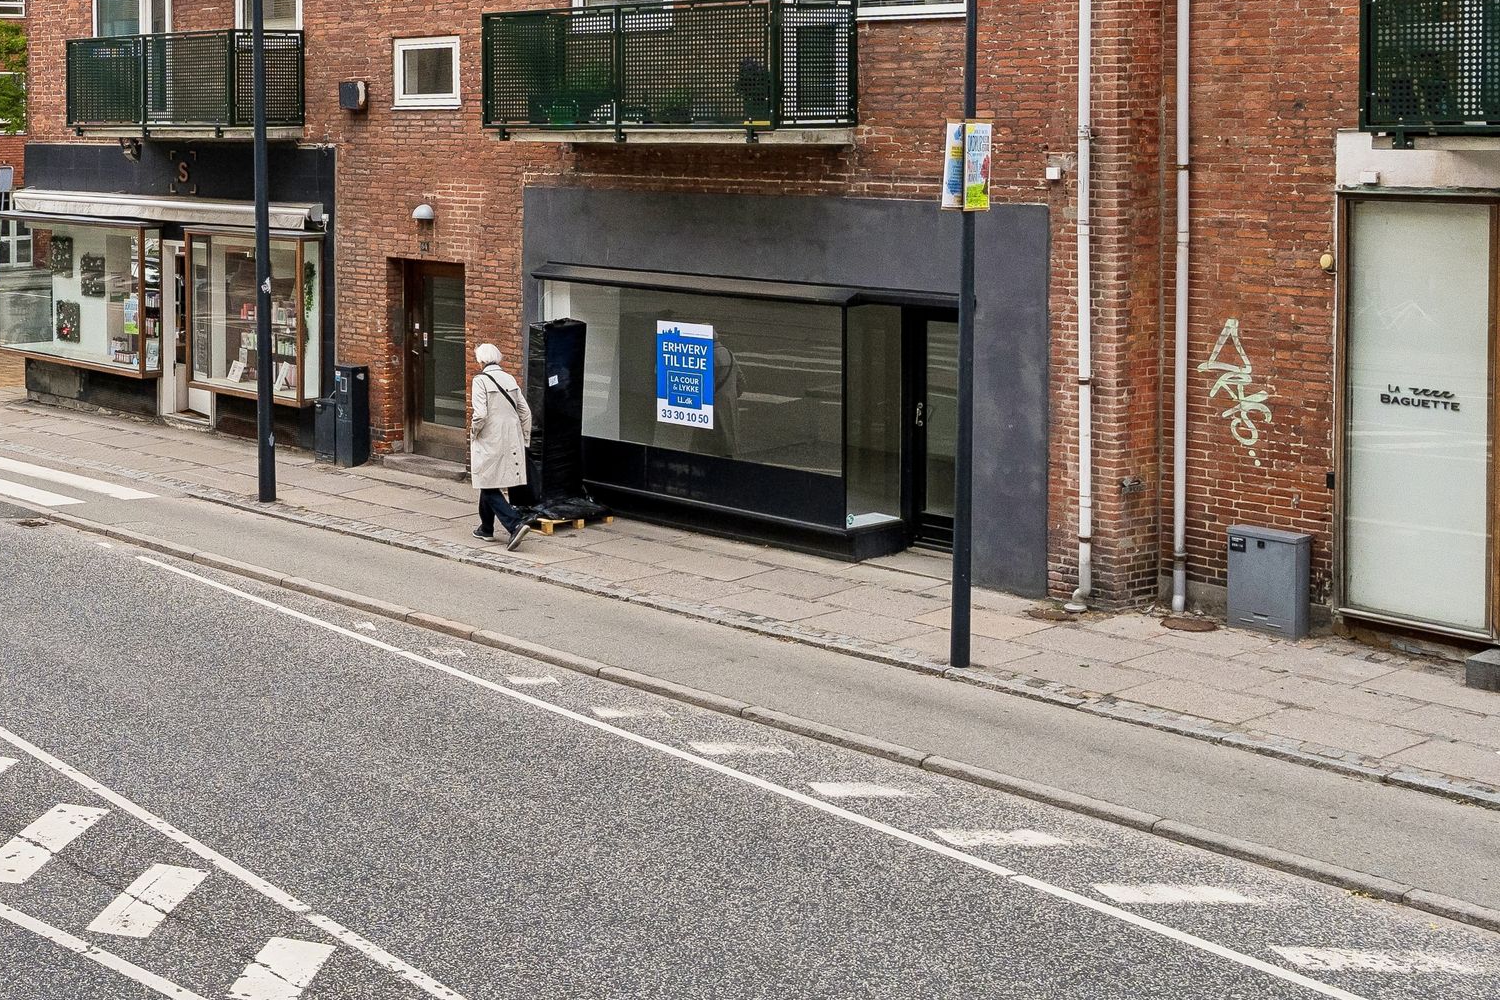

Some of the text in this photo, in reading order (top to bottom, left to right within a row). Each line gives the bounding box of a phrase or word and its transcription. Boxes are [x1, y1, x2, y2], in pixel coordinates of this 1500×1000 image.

[179, 161, 188, 182] S
[662, 341, 708, 356] ERHVERV
[662, 354, 707, 370] TIL LEJE
[670, 375, 700, 385] LA COUR
[672, 383, 700, 393] & LYKKE
[1388, 383, 1401, 394] LA
[1380, 393, 1460, 412] BAGUETTE
[661, 408, 709, 424] 33 30 10 50
